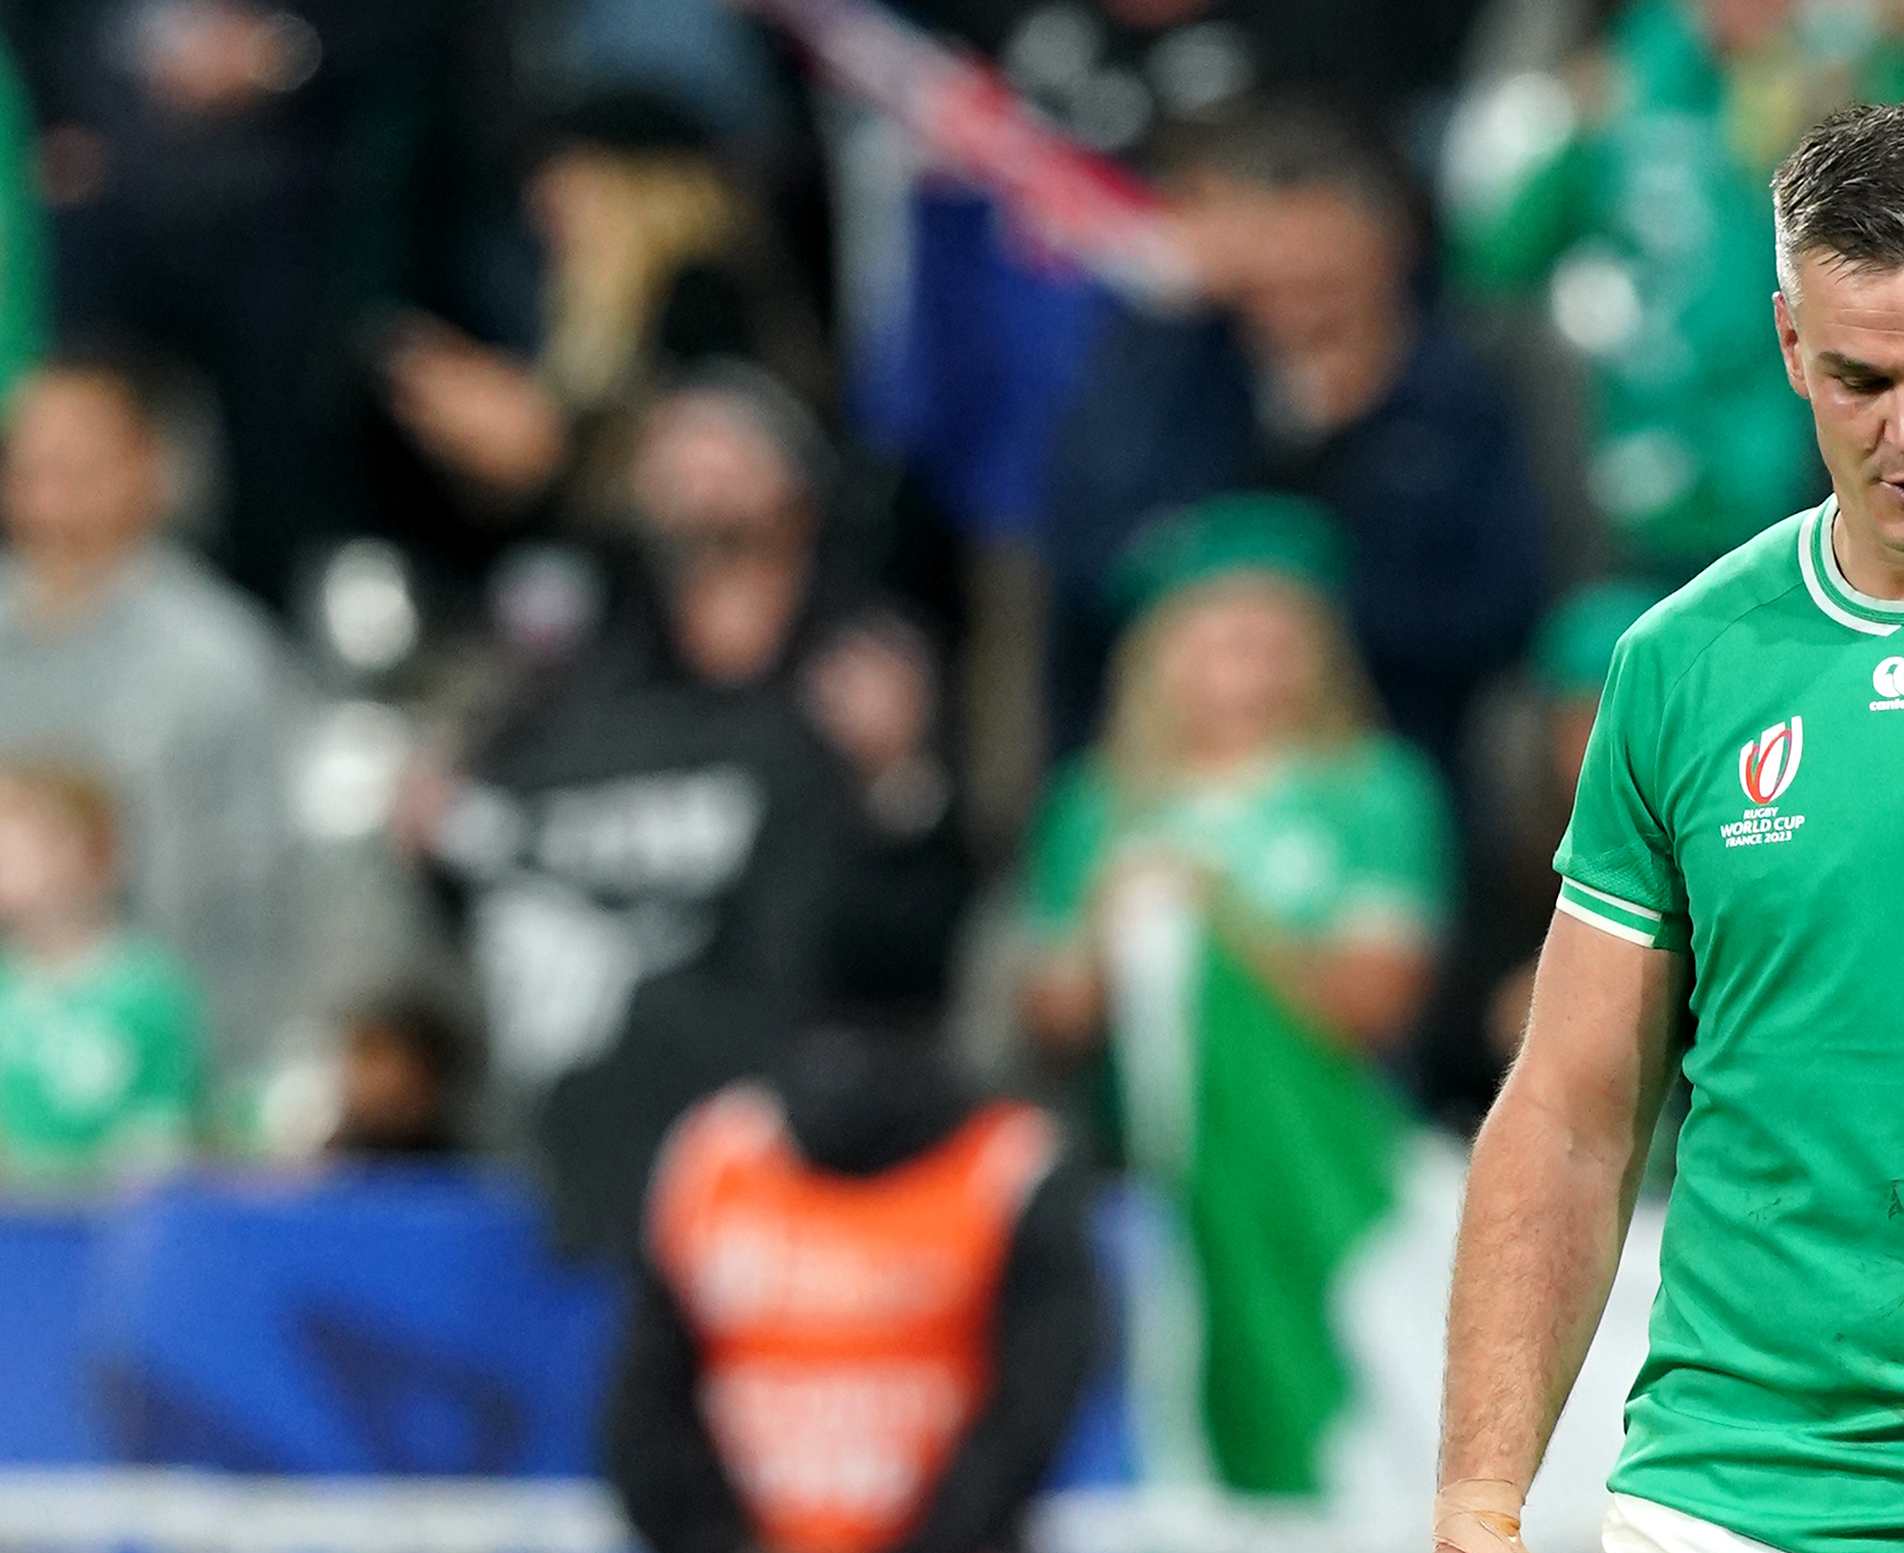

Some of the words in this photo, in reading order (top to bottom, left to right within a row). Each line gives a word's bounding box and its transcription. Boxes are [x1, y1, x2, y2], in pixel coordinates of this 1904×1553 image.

[1743, 807, 1779, 819] RUGBY
[1720, 818, 1771, 838] WORLD
[1773, 815, 1805, 831] CUP
[1725, 834, 1762, 848] FRANCE
[1764, 830, 1792, 844] 2023
